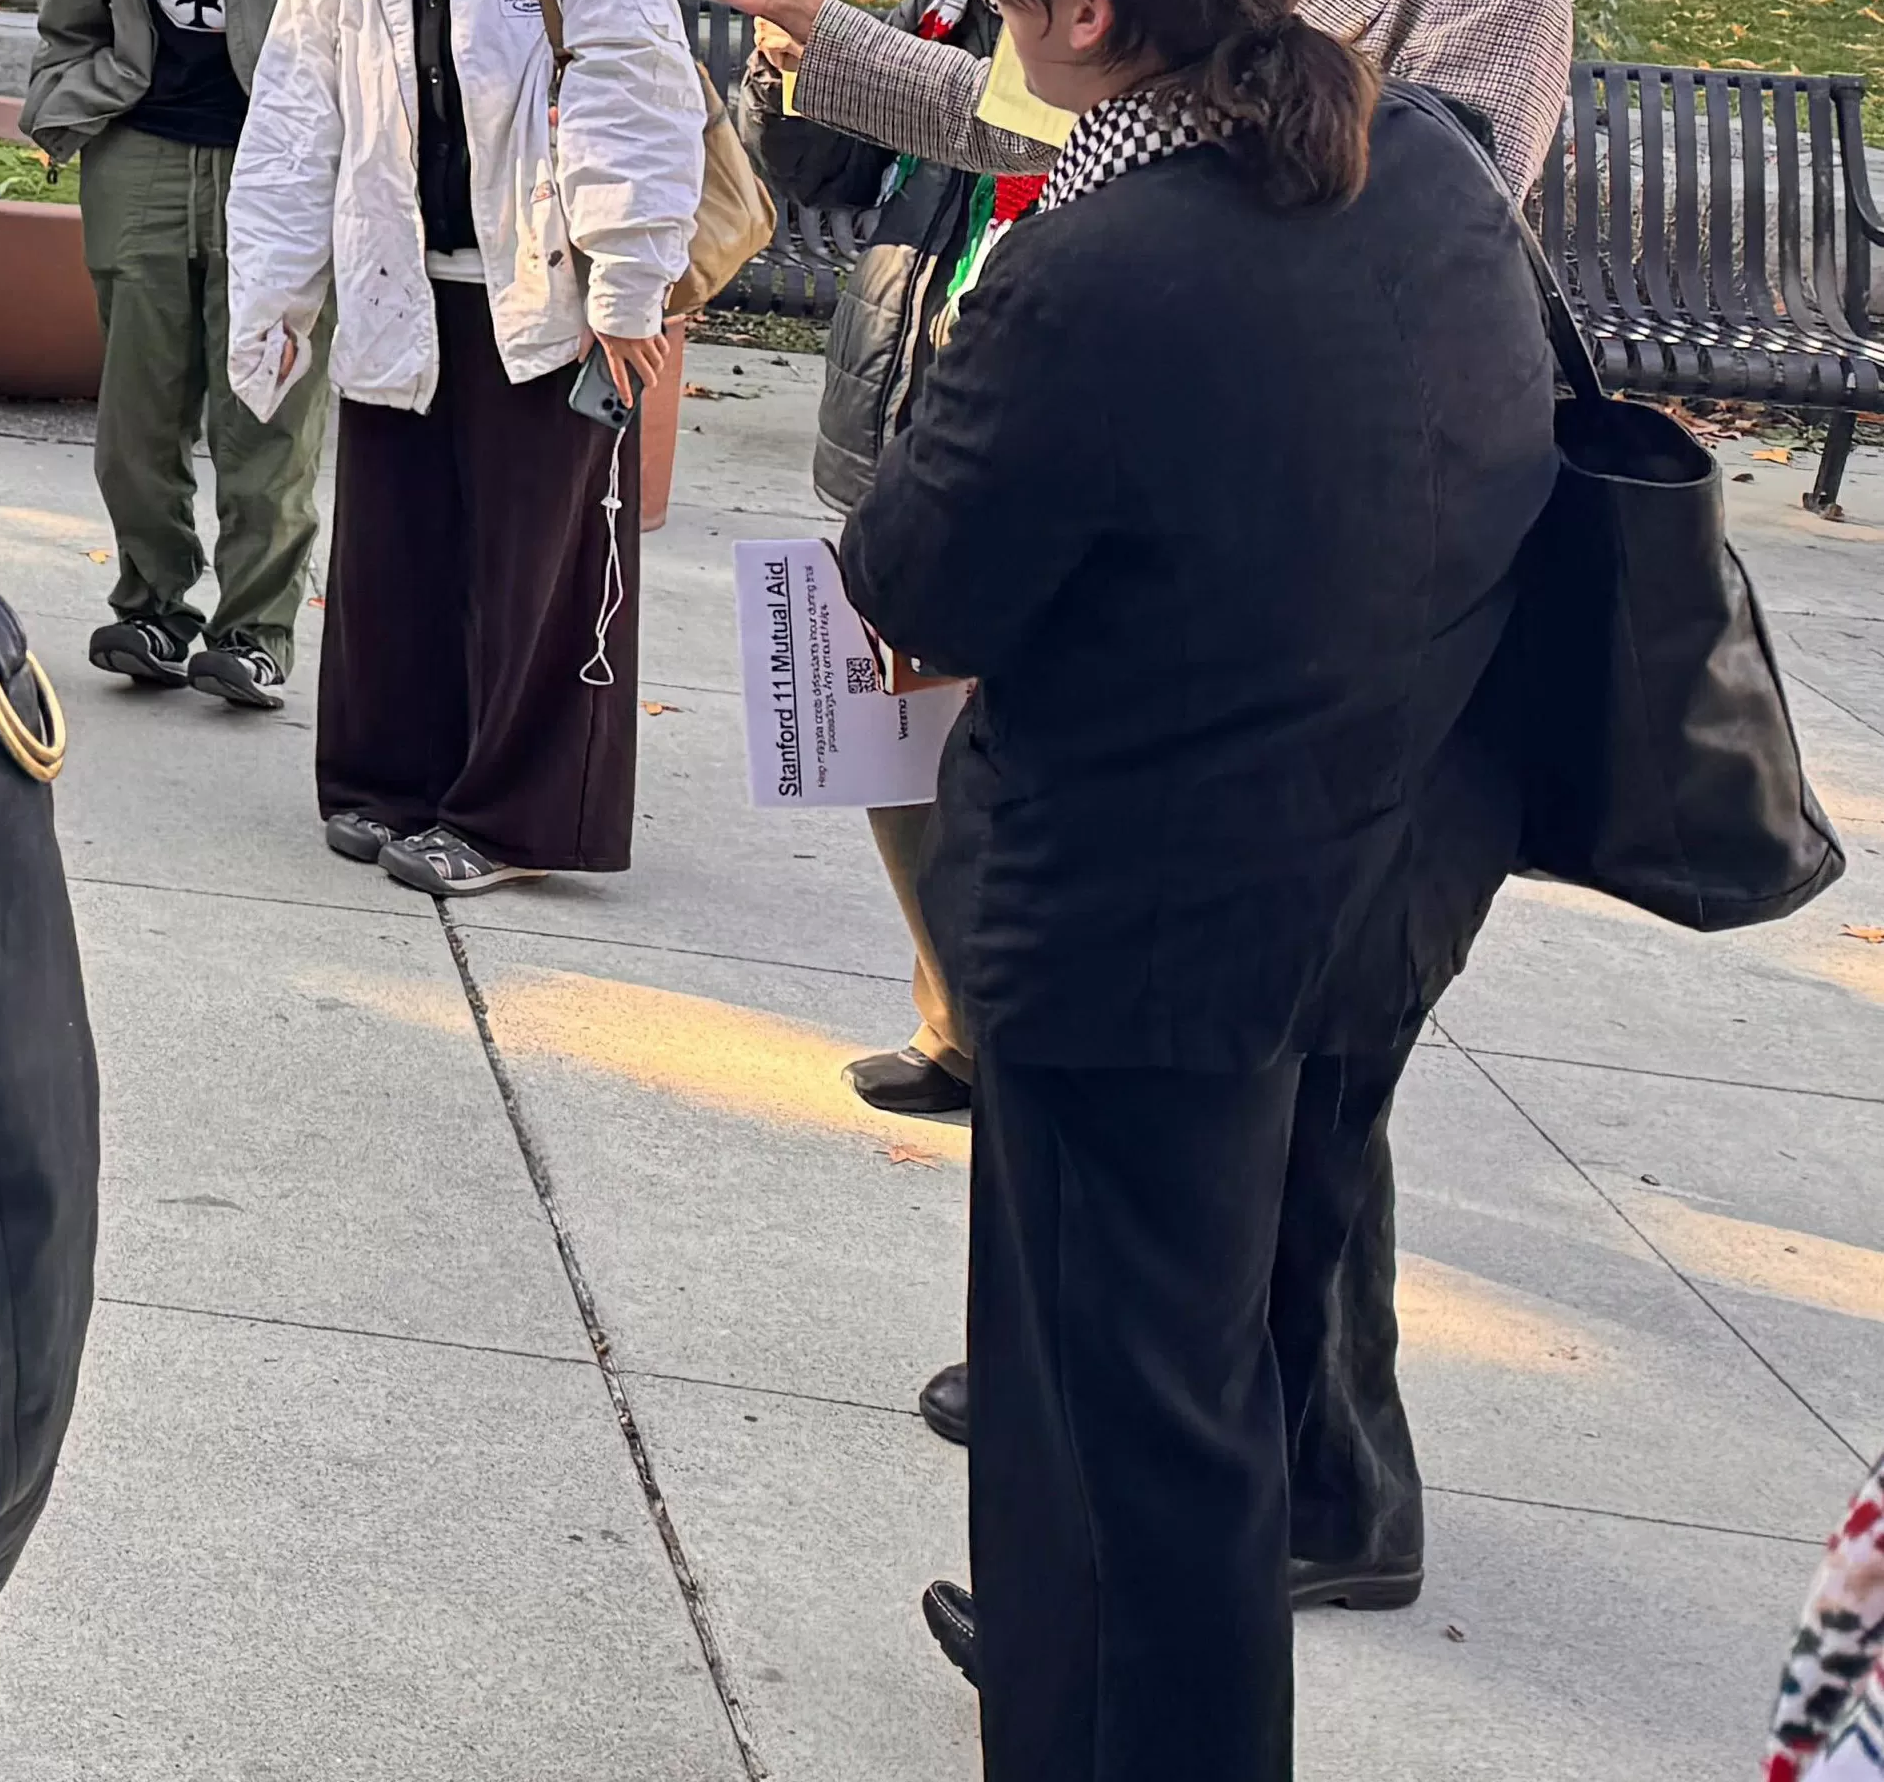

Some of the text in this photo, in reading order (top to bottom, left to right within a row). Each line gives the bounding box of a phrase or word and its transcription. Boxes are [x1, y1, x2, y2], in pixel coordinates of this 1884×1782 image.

[765, 562, 800, 797] Stanford 11 Mutual Aid
